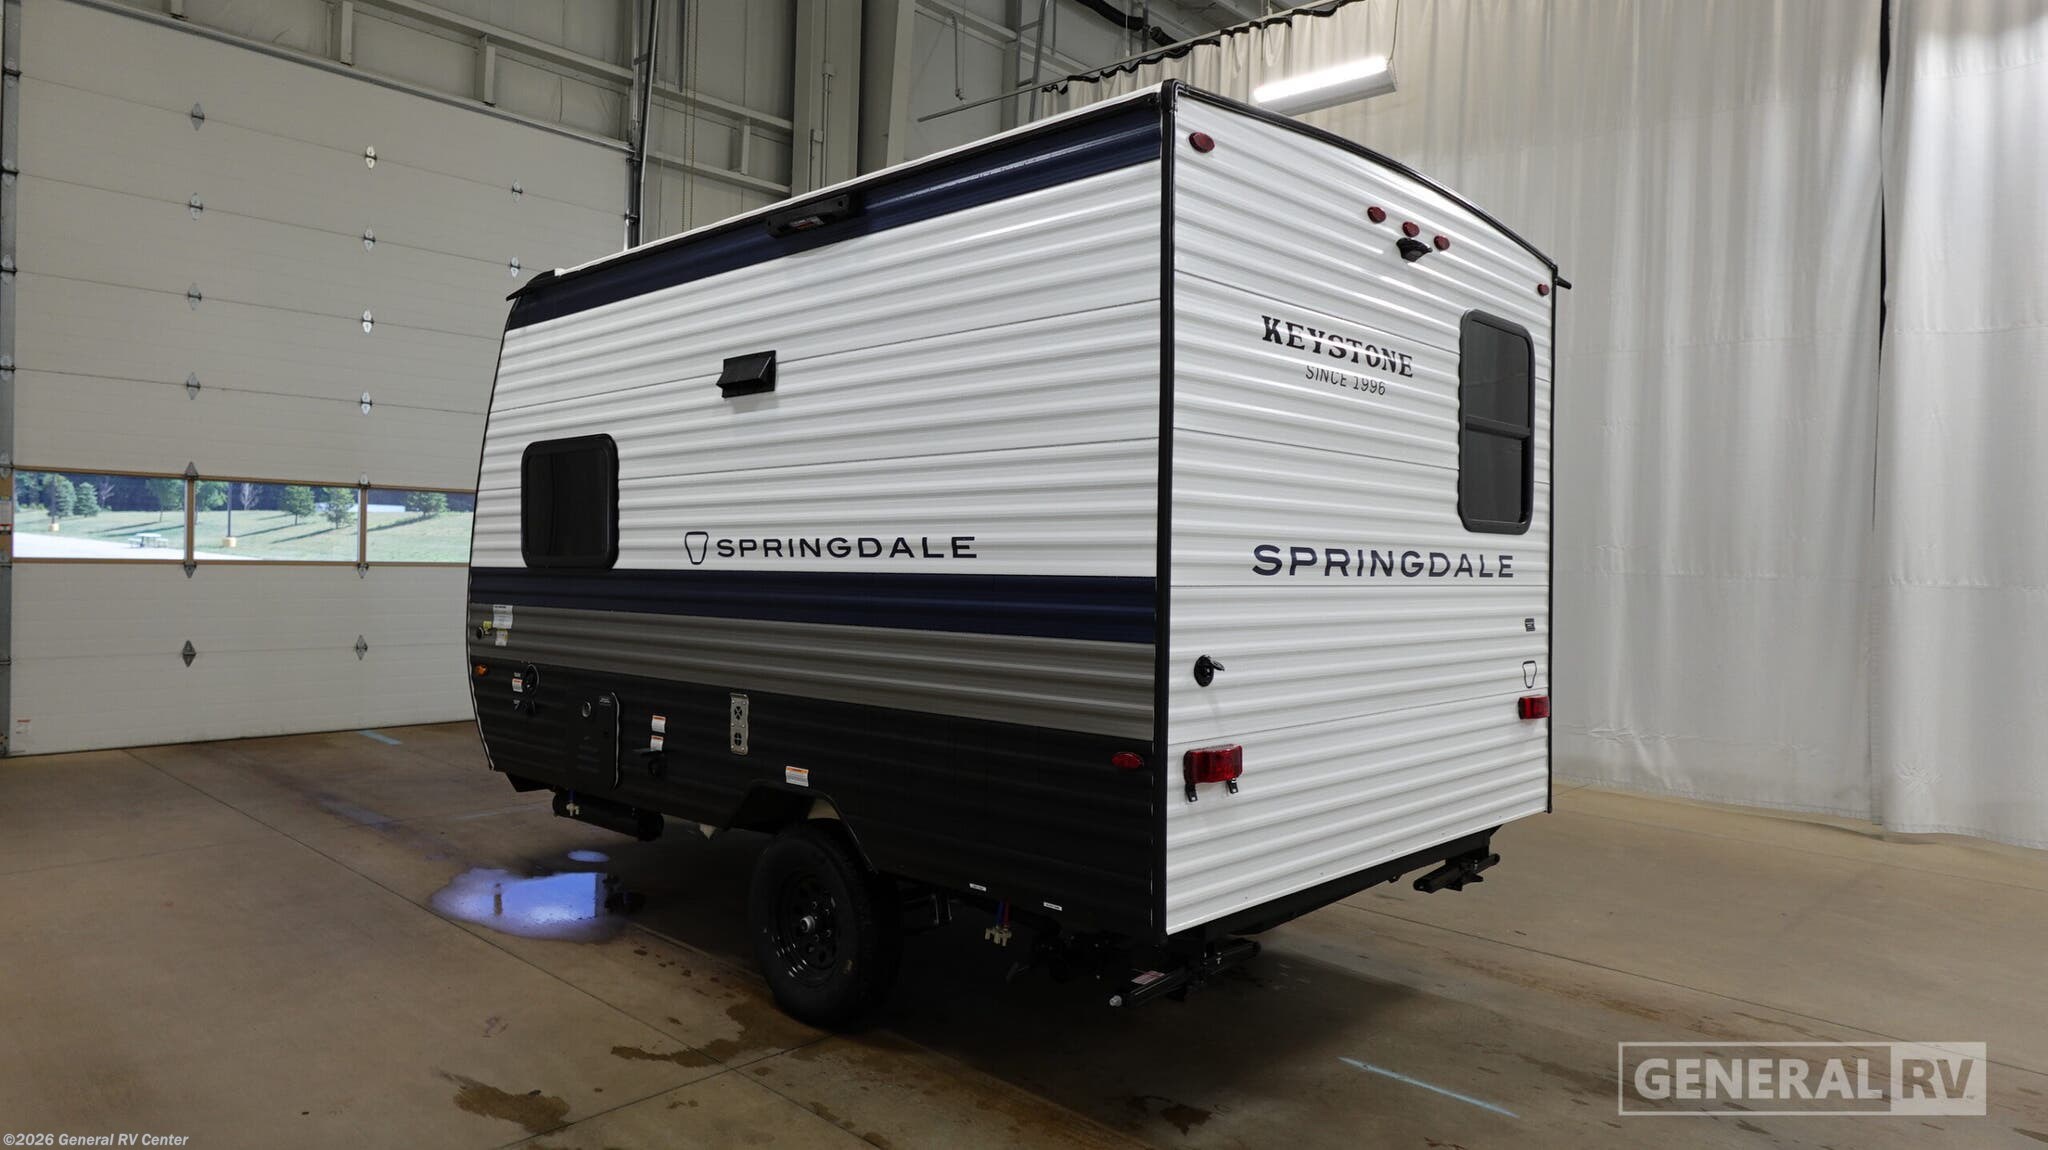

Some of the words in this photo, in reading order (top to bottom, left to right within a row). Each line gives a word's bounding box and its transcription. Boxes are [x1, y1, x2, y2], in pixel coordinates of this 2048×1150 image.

[1261, 315, 1414, 378] KEYSTONE
[1305, 364, 1348, 387] SINCE
[1352, 375, 1387, 396] 1996
[716, 536, 978, 559] SPRINGDALE
[1252, 544, 1514, 578] SPRINGDALE
